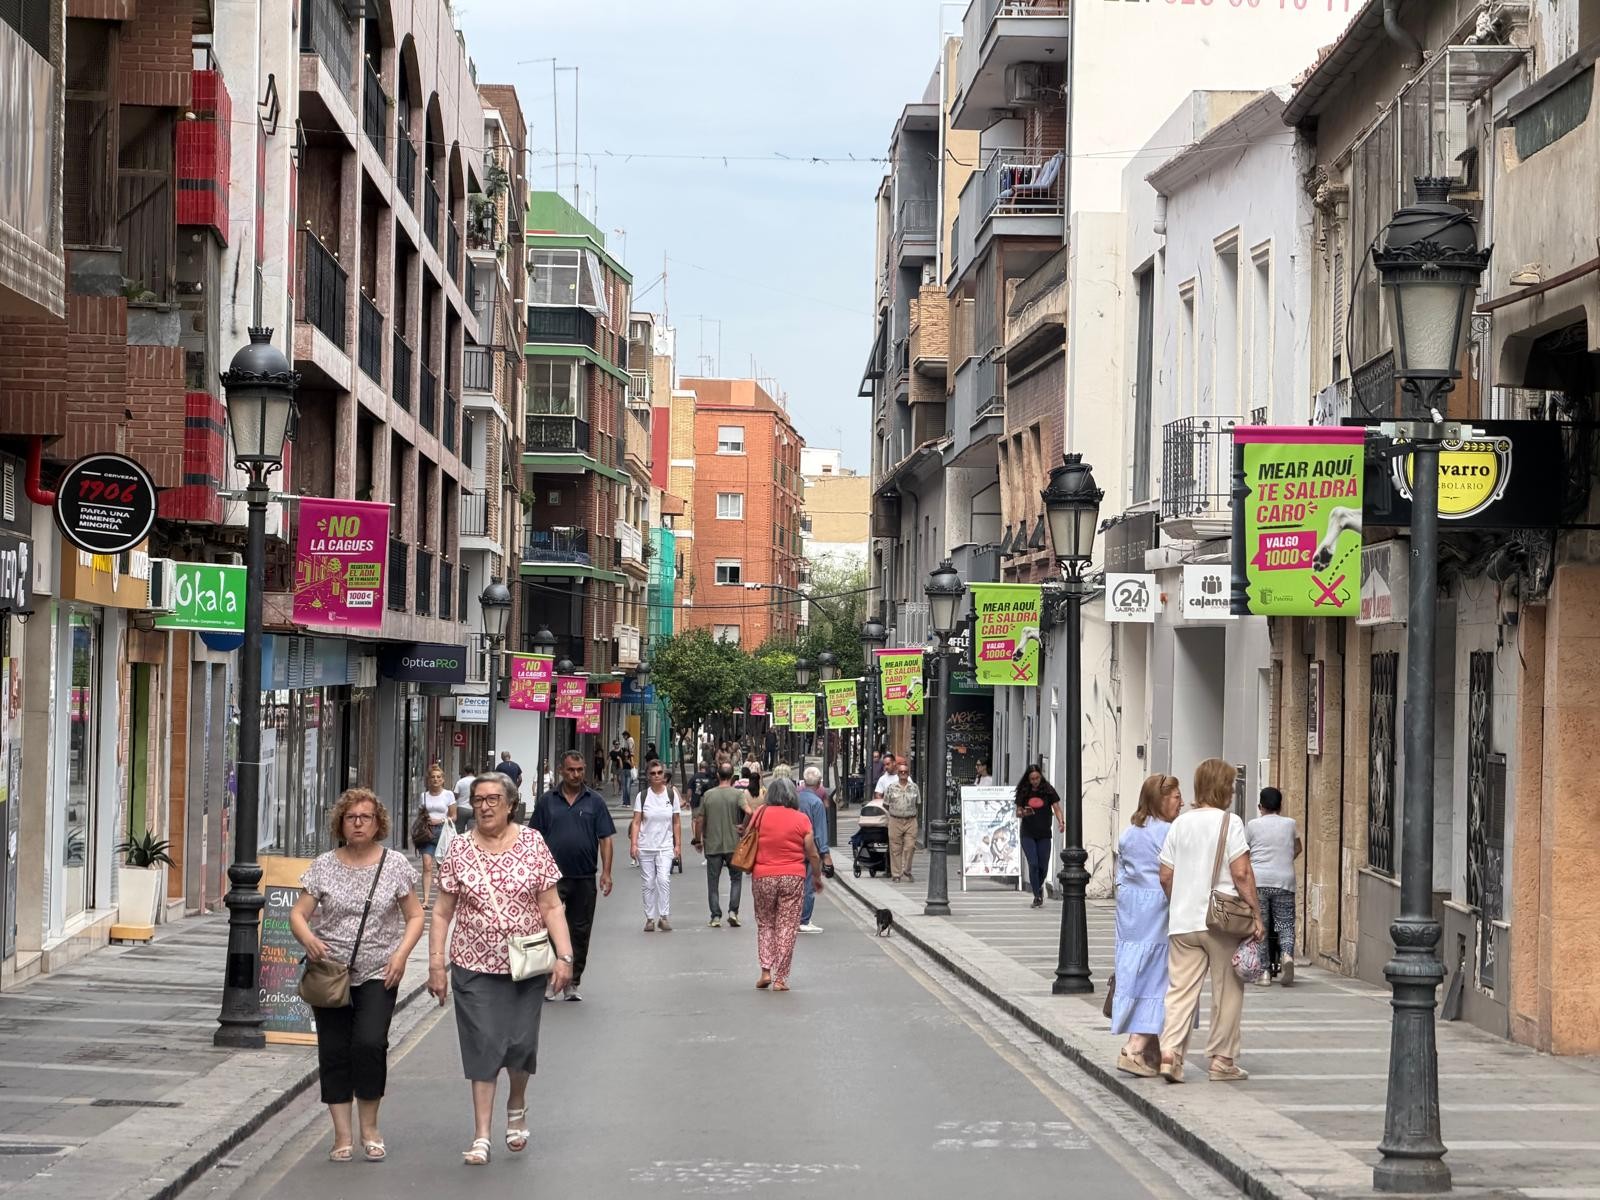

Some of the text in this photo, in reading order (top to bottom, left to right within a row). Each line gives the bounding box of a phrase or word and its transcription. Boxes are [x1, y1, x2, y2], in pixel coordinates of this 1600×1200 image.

[1258, 455, 1353, 480] MEAR AQUÍ
[1438, 464, 1490, 477] varro
[104, 472, 138, 481] CERVEZAS
[79, 480, 138, 503] 1906
[1258, 474, 1357, 501] TE SALDRÁ
[1438, 482, 1484, 491] BOLARIO
[79, 514, 122, 525] INMENSA
[80, 507, 130, 519] PARA UNA
[1257, 503, 1306, 523] CARO
[78, 520, 119, 531] MINORÍA
[328, 516, 360, 538] NO
[310, 539, 374, 552] LA CAGUES
[1266, 536, 1298, 548] VALGO
[176, 571, 237, 617] Okala
[983, 599, 1035, 612] MEAR AQUÍ
[1189, 596, 1232, 609] cajama
[983, 614, 994, 623] TE
[982, 625, 1008, 635] CARO
[526, 661, 541, 671] NO
[259, 988, 304, 1004] Croissan
